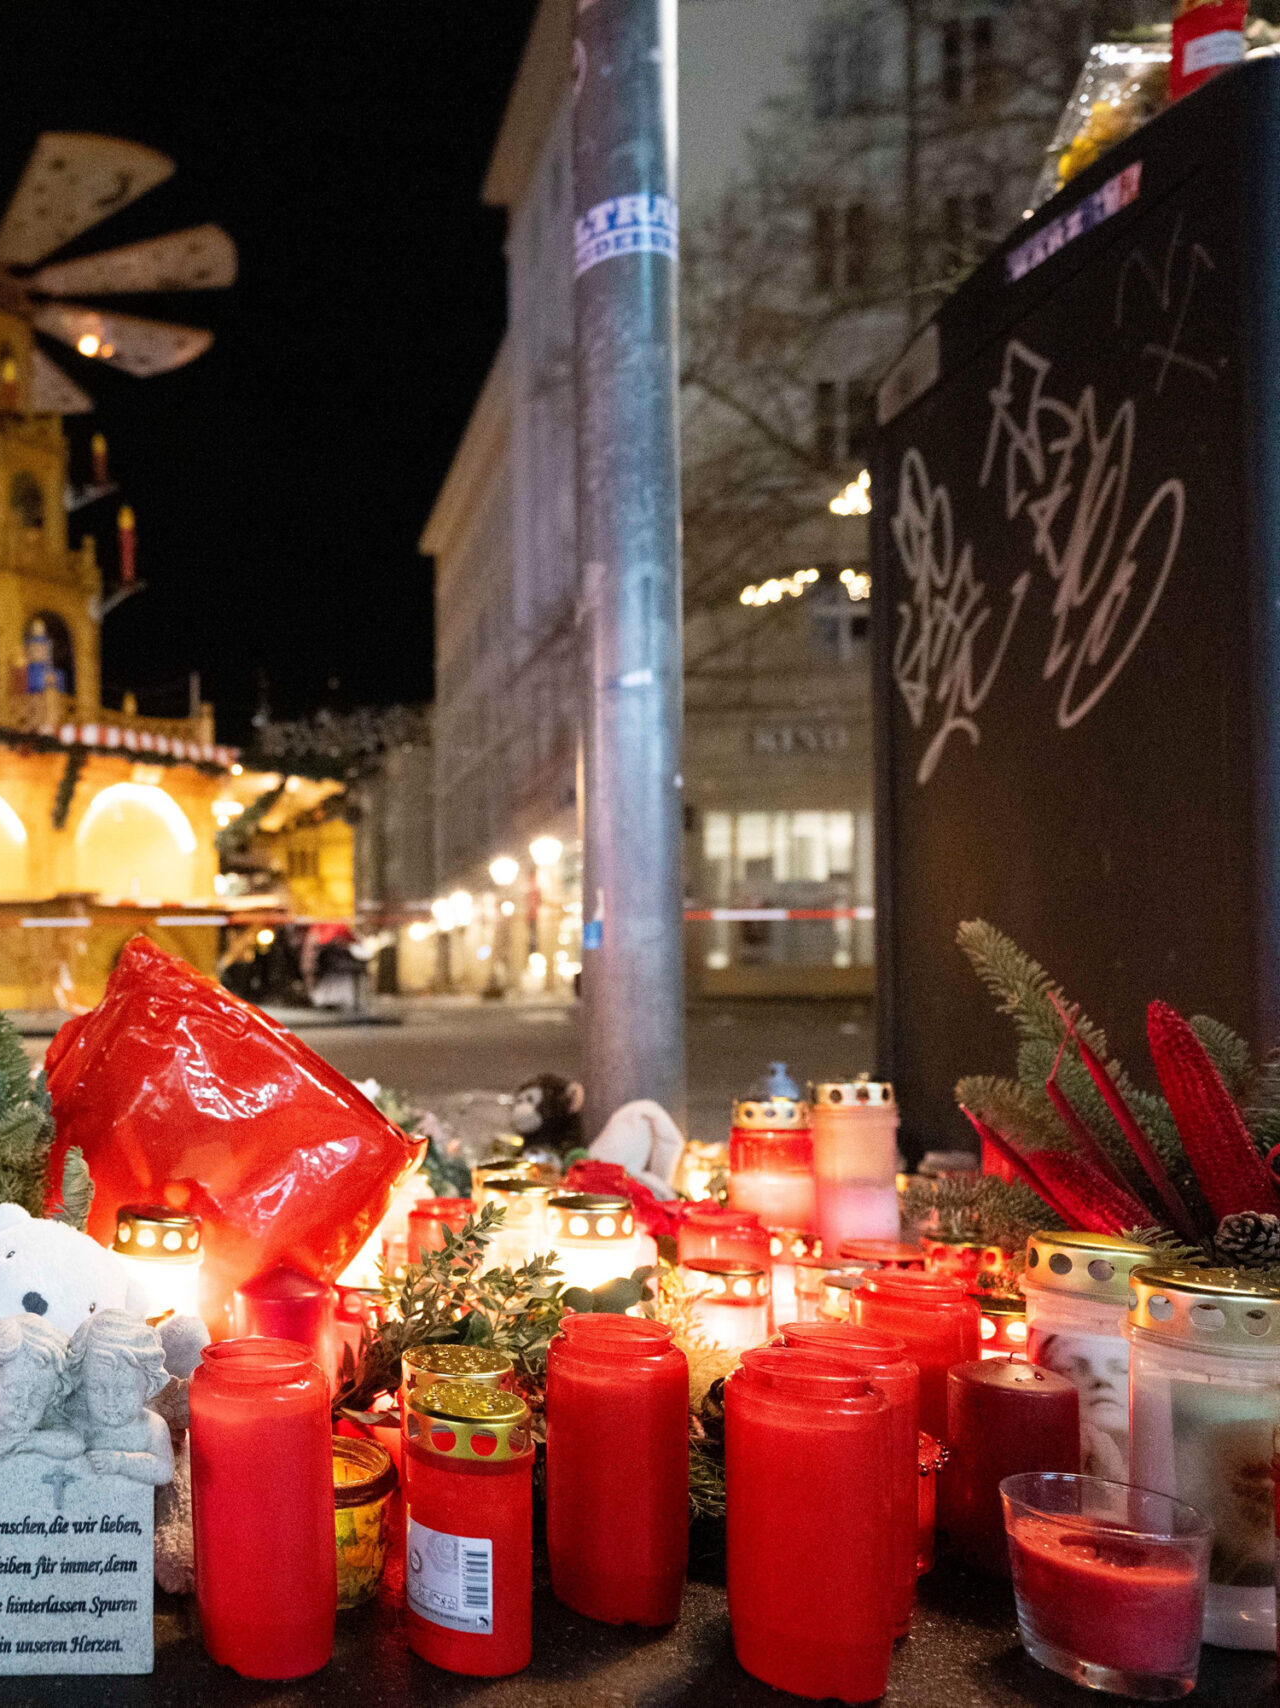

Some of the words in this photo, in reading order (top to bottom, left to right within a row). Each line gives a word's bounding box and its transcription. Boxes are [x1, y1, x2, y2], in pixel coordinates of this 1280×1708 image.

[72, 1516, 98, 1534] wir
[99, 1514, 143, 1536] lieben,
[30, 1555, 58, 1580] für
[5, 1595, 87, 1615] hinterlassen
[88, 1595, 138, 1619] Spuren
[15, 1638, 68, 1654] unseren
[69, 1635, 124, 1654] Herzen.
